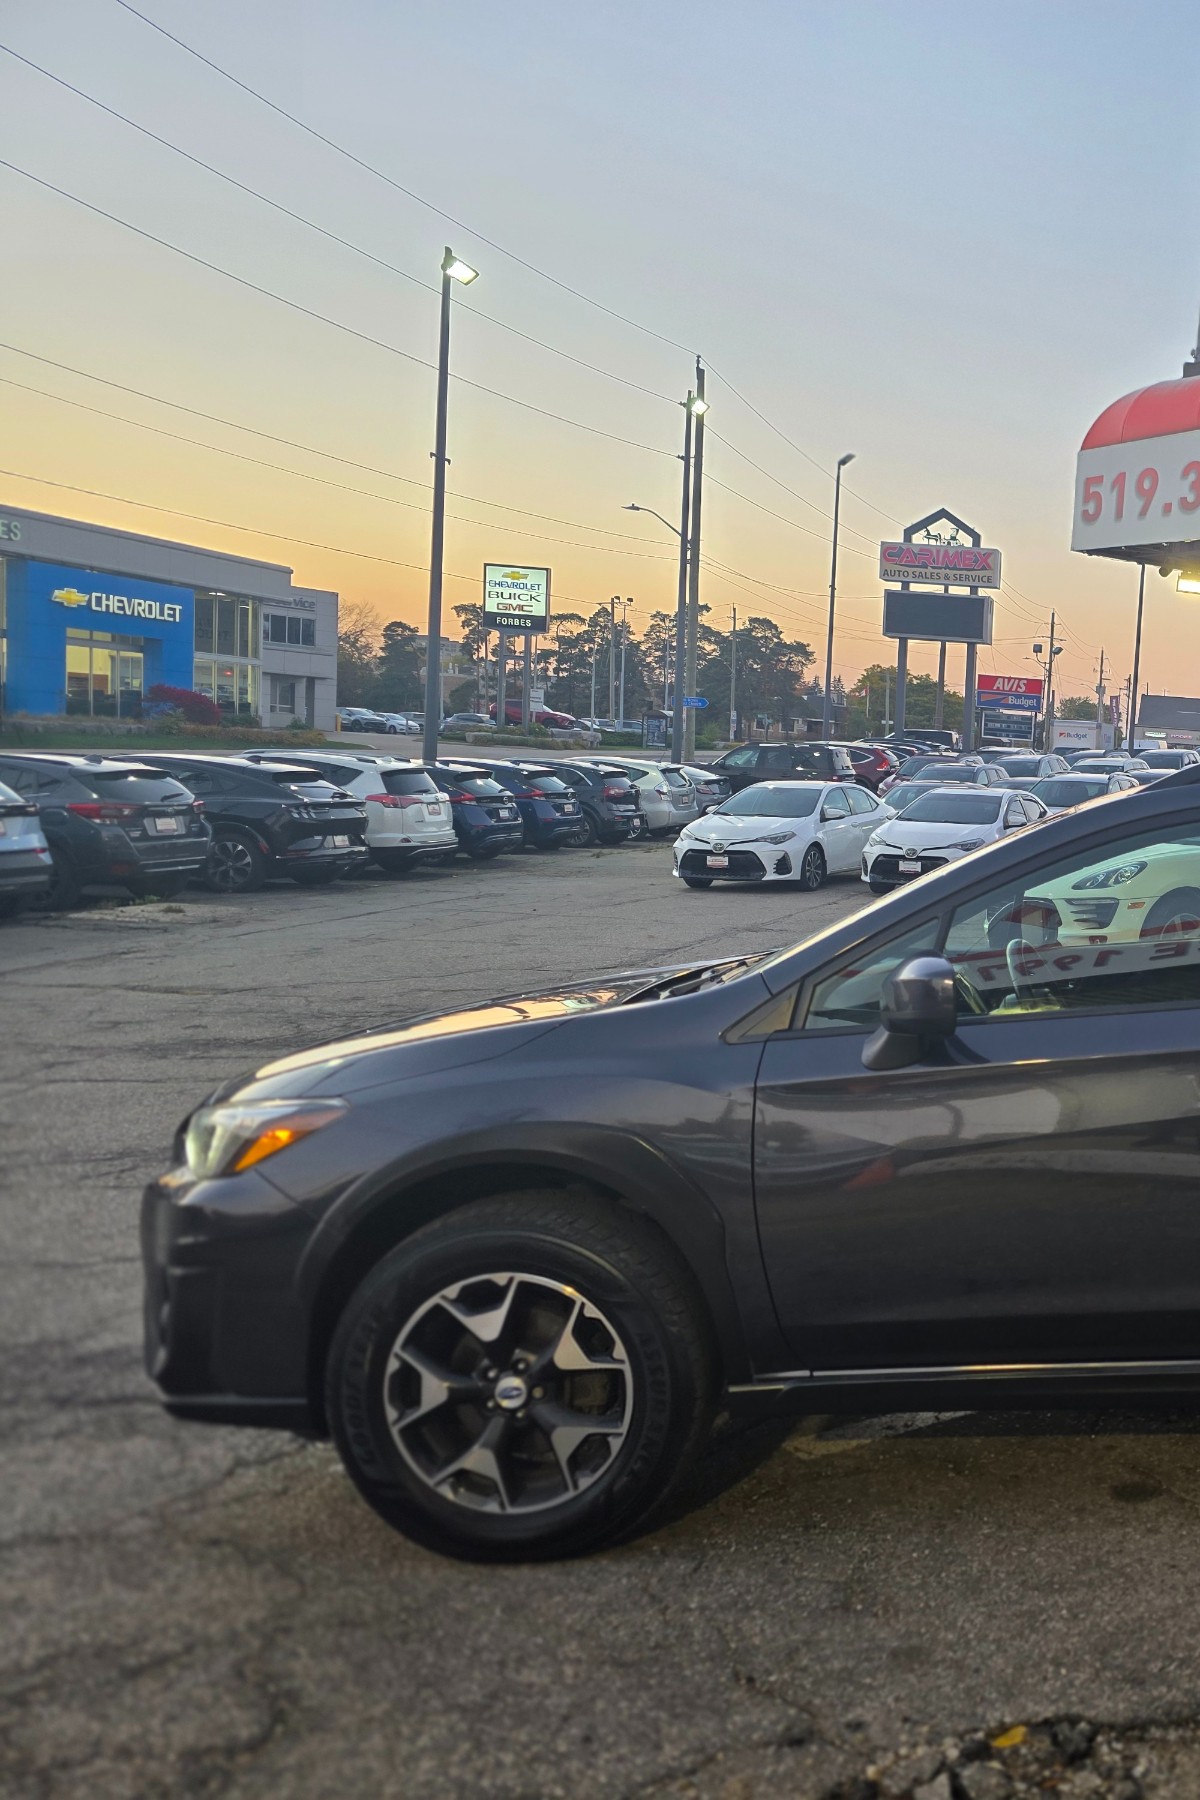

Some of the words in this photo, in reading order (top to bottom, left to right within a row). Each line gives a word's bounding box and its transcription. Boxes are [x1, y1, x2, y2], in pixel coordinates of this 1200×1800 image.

[882, 545, 993, 570] CARIMEX
[882, 568, 909, 578] AUTO
[911, 570, 941, 580] SALES
[943, 573, 951, 581] &
[953, 573, 993, 583] SERVICE
[488, 580, 542, 591] CHEVROLET
[488, 591, 542, 602] BUICK
[91, 592, 182, 622] CHEVROLET
[496, 602, 533, 613] GMC
[496, 617, 531, 627] FORBES
[993, 678, 1028, 692] AVIS
[1008, 695, 1037, 707] Budget
